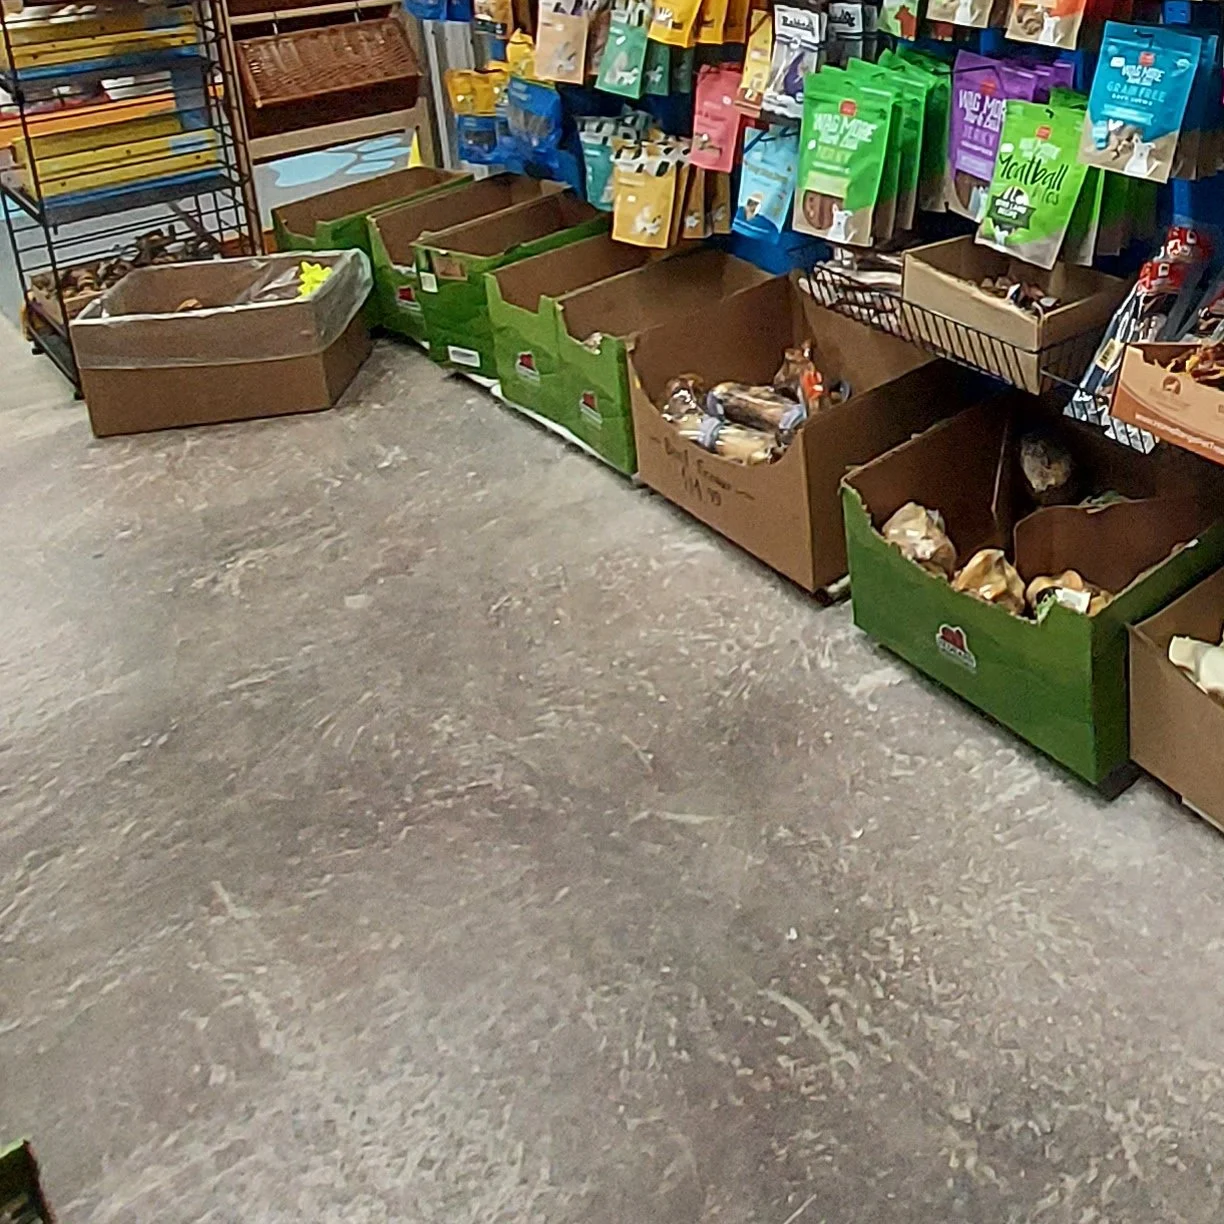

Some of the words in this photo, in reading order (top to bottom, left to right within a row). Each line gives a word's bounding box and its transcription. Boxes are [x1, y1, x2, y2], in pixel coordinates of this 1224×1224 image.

[1107, 81, 1137, 95] GRAIN
[1139, 86, 1166, 103] FREE
[813, 113, 840, 134] WAG
[840, 116, 878, 142] MORE
[999, 154, 1069, 191] Meatball
